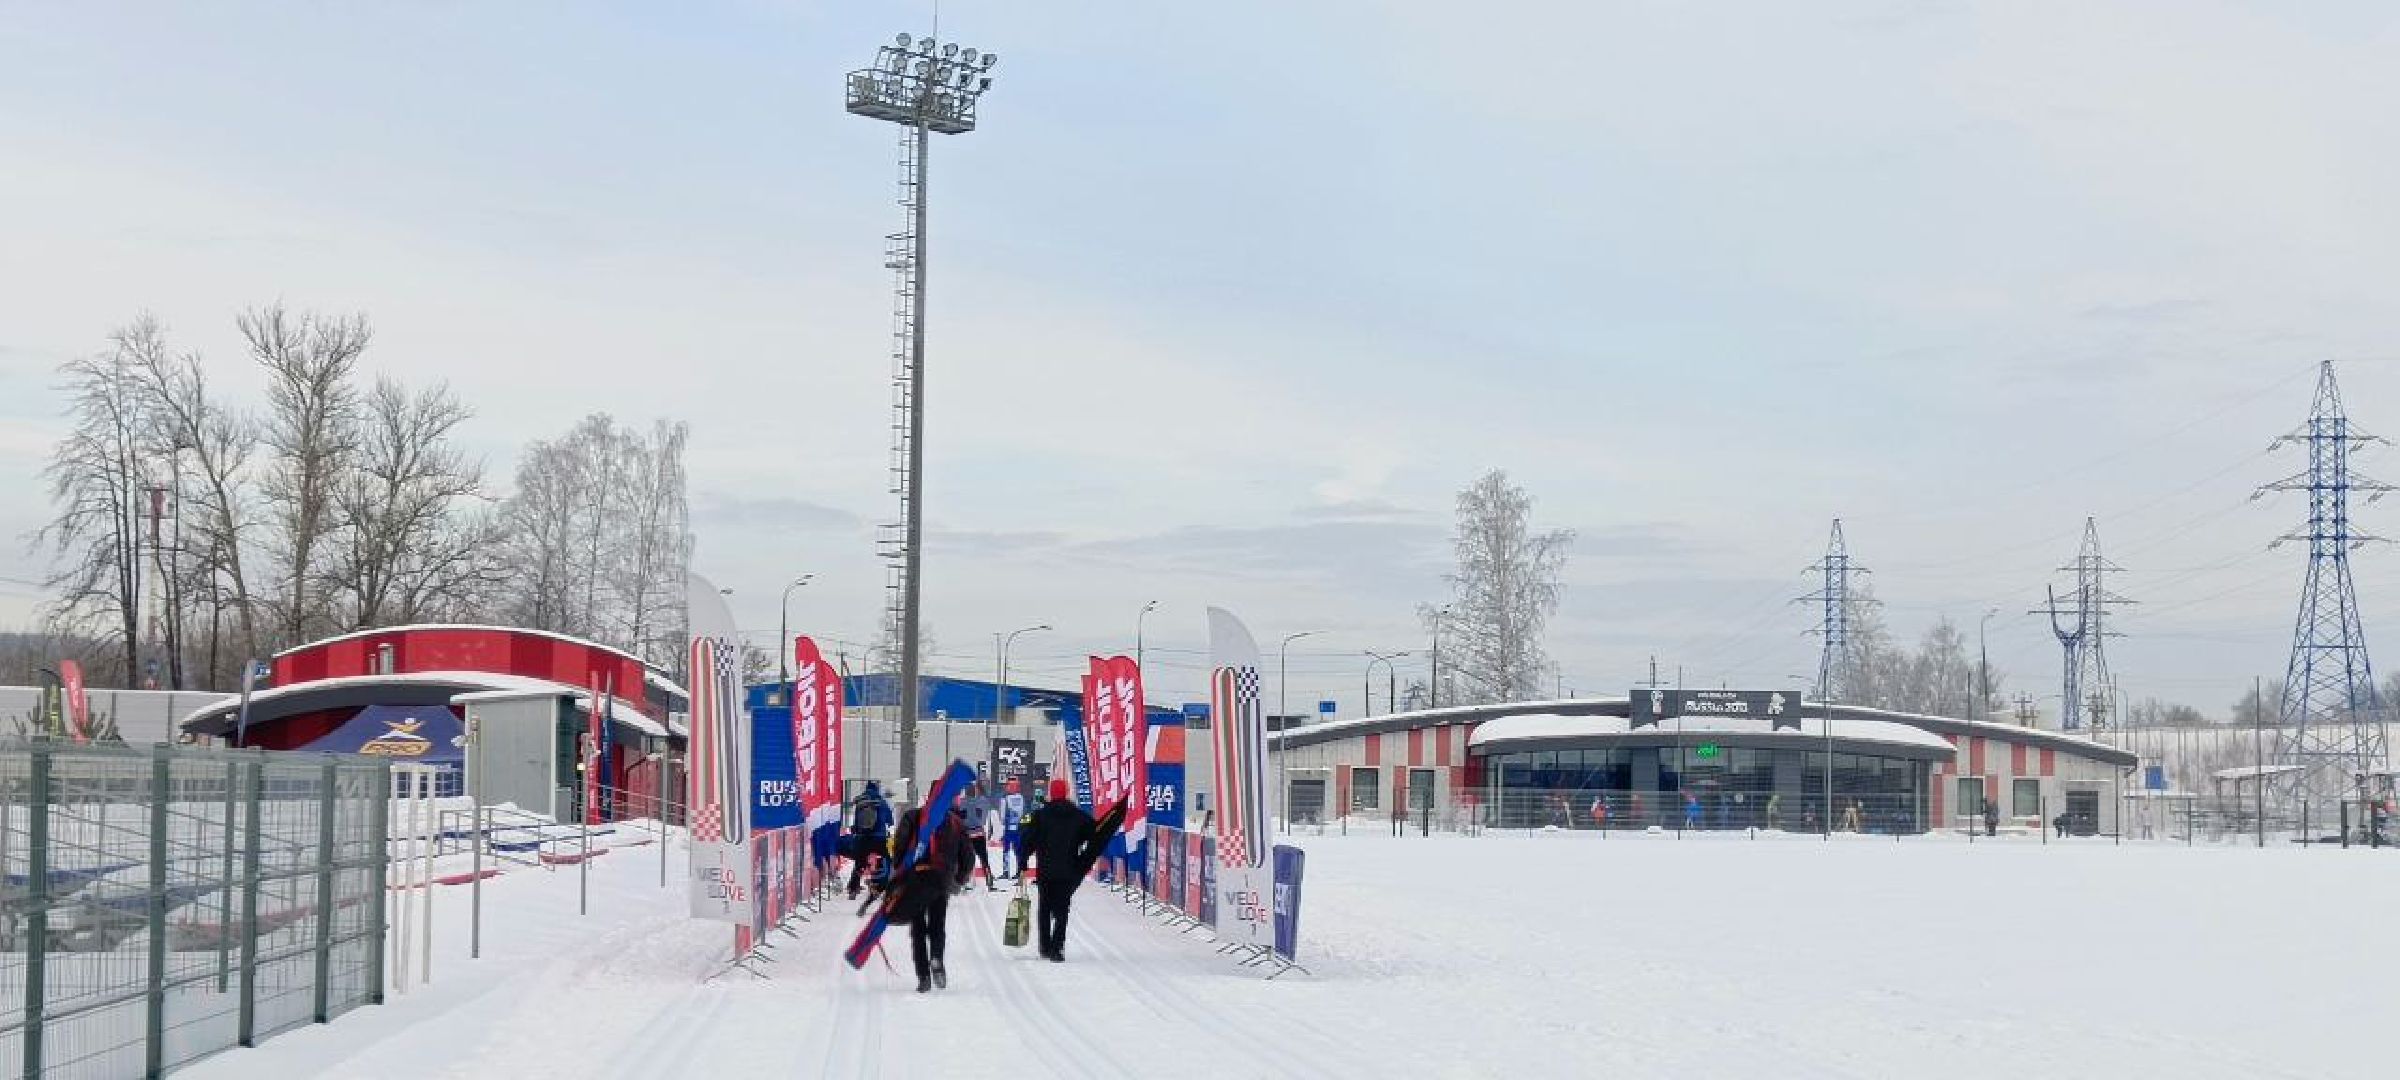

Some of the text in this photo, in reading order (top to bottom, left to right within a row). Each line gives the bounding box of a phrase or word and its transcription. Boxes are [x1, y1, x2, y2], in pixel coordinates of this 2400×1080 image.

[708, 885, 748, 902] LOVE
[1225, 891, 1258, 906] VELO
[1237, 906, 1268, 923] LOVE
